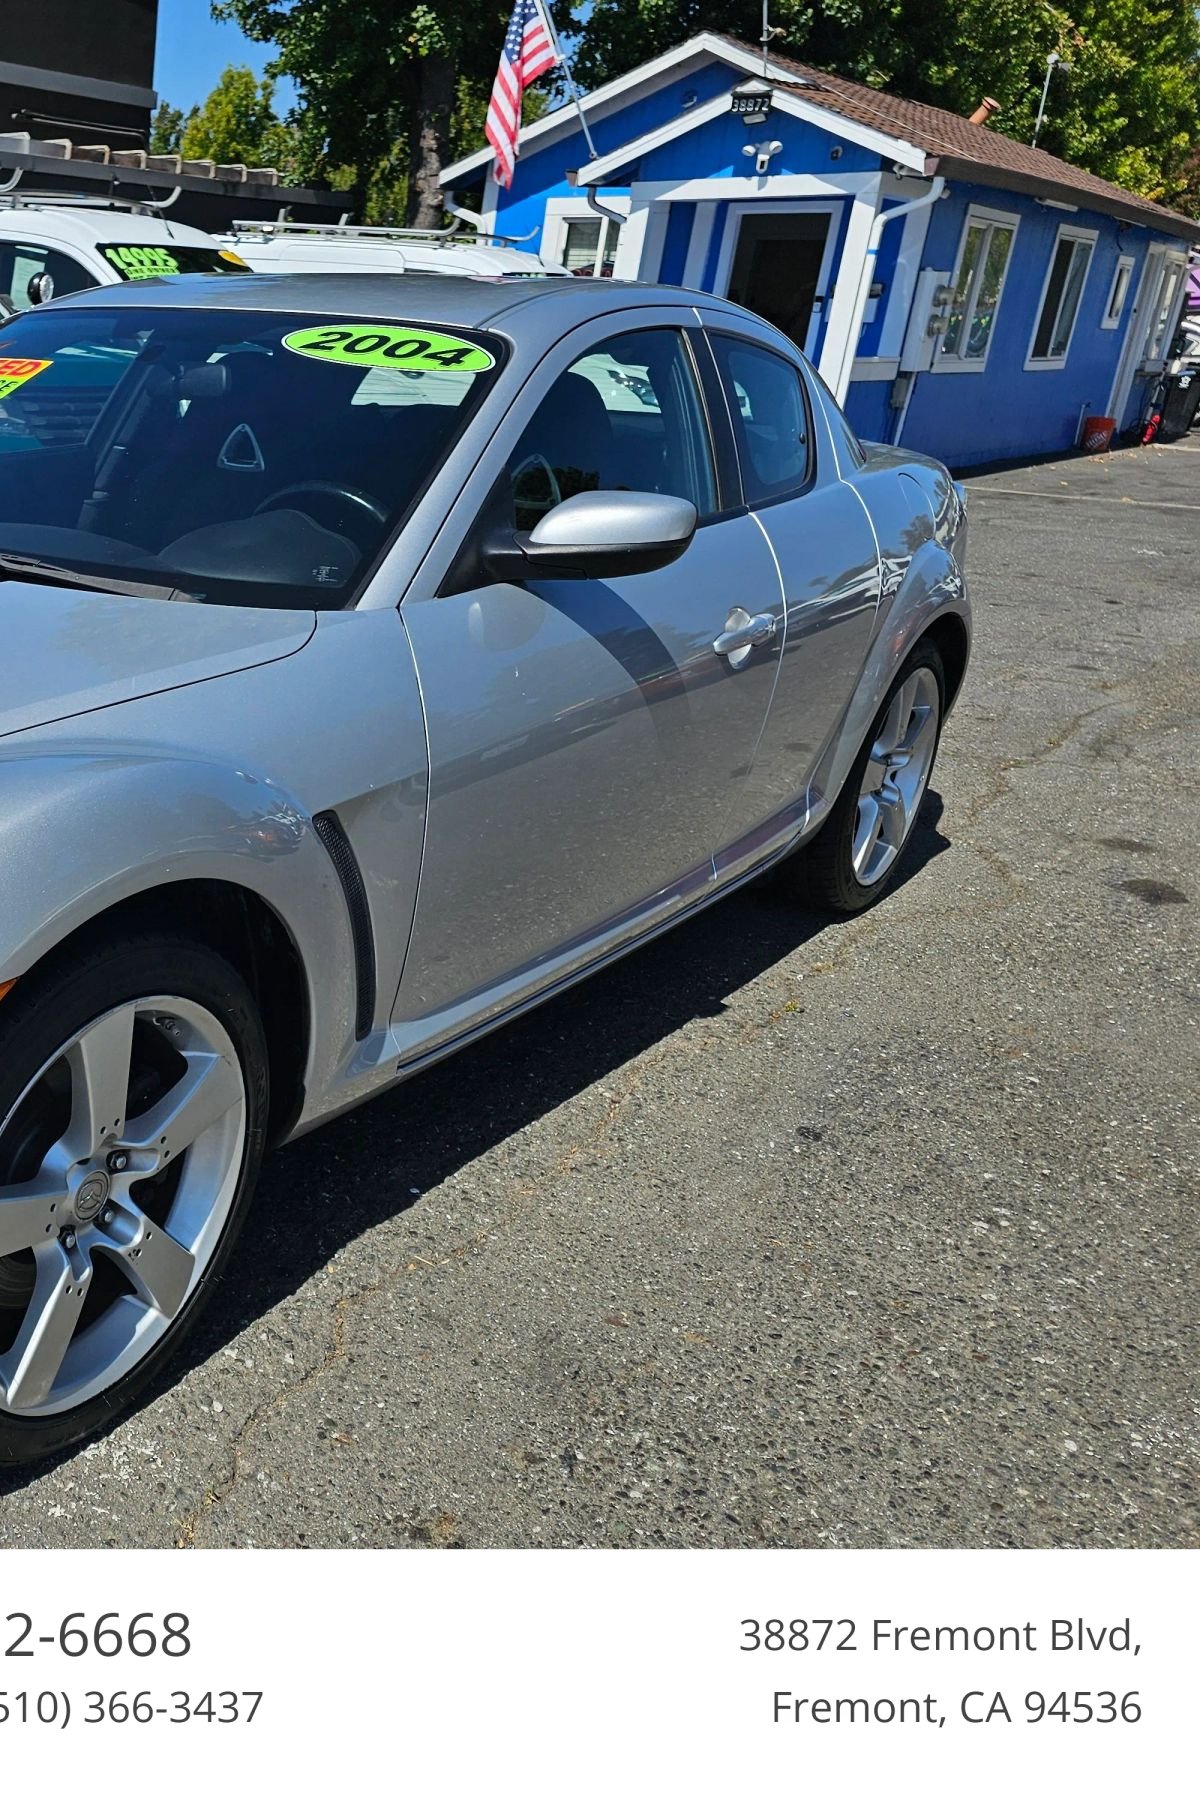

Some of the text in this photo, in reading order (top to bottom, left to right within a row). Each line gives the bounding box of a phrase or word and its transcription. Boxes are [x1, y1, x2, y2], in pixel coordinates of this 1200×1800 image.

[731, 98, 770, 112] 38872
[105, 247, 178, 269] 14995
[298, 331, 477, 367] 2004
